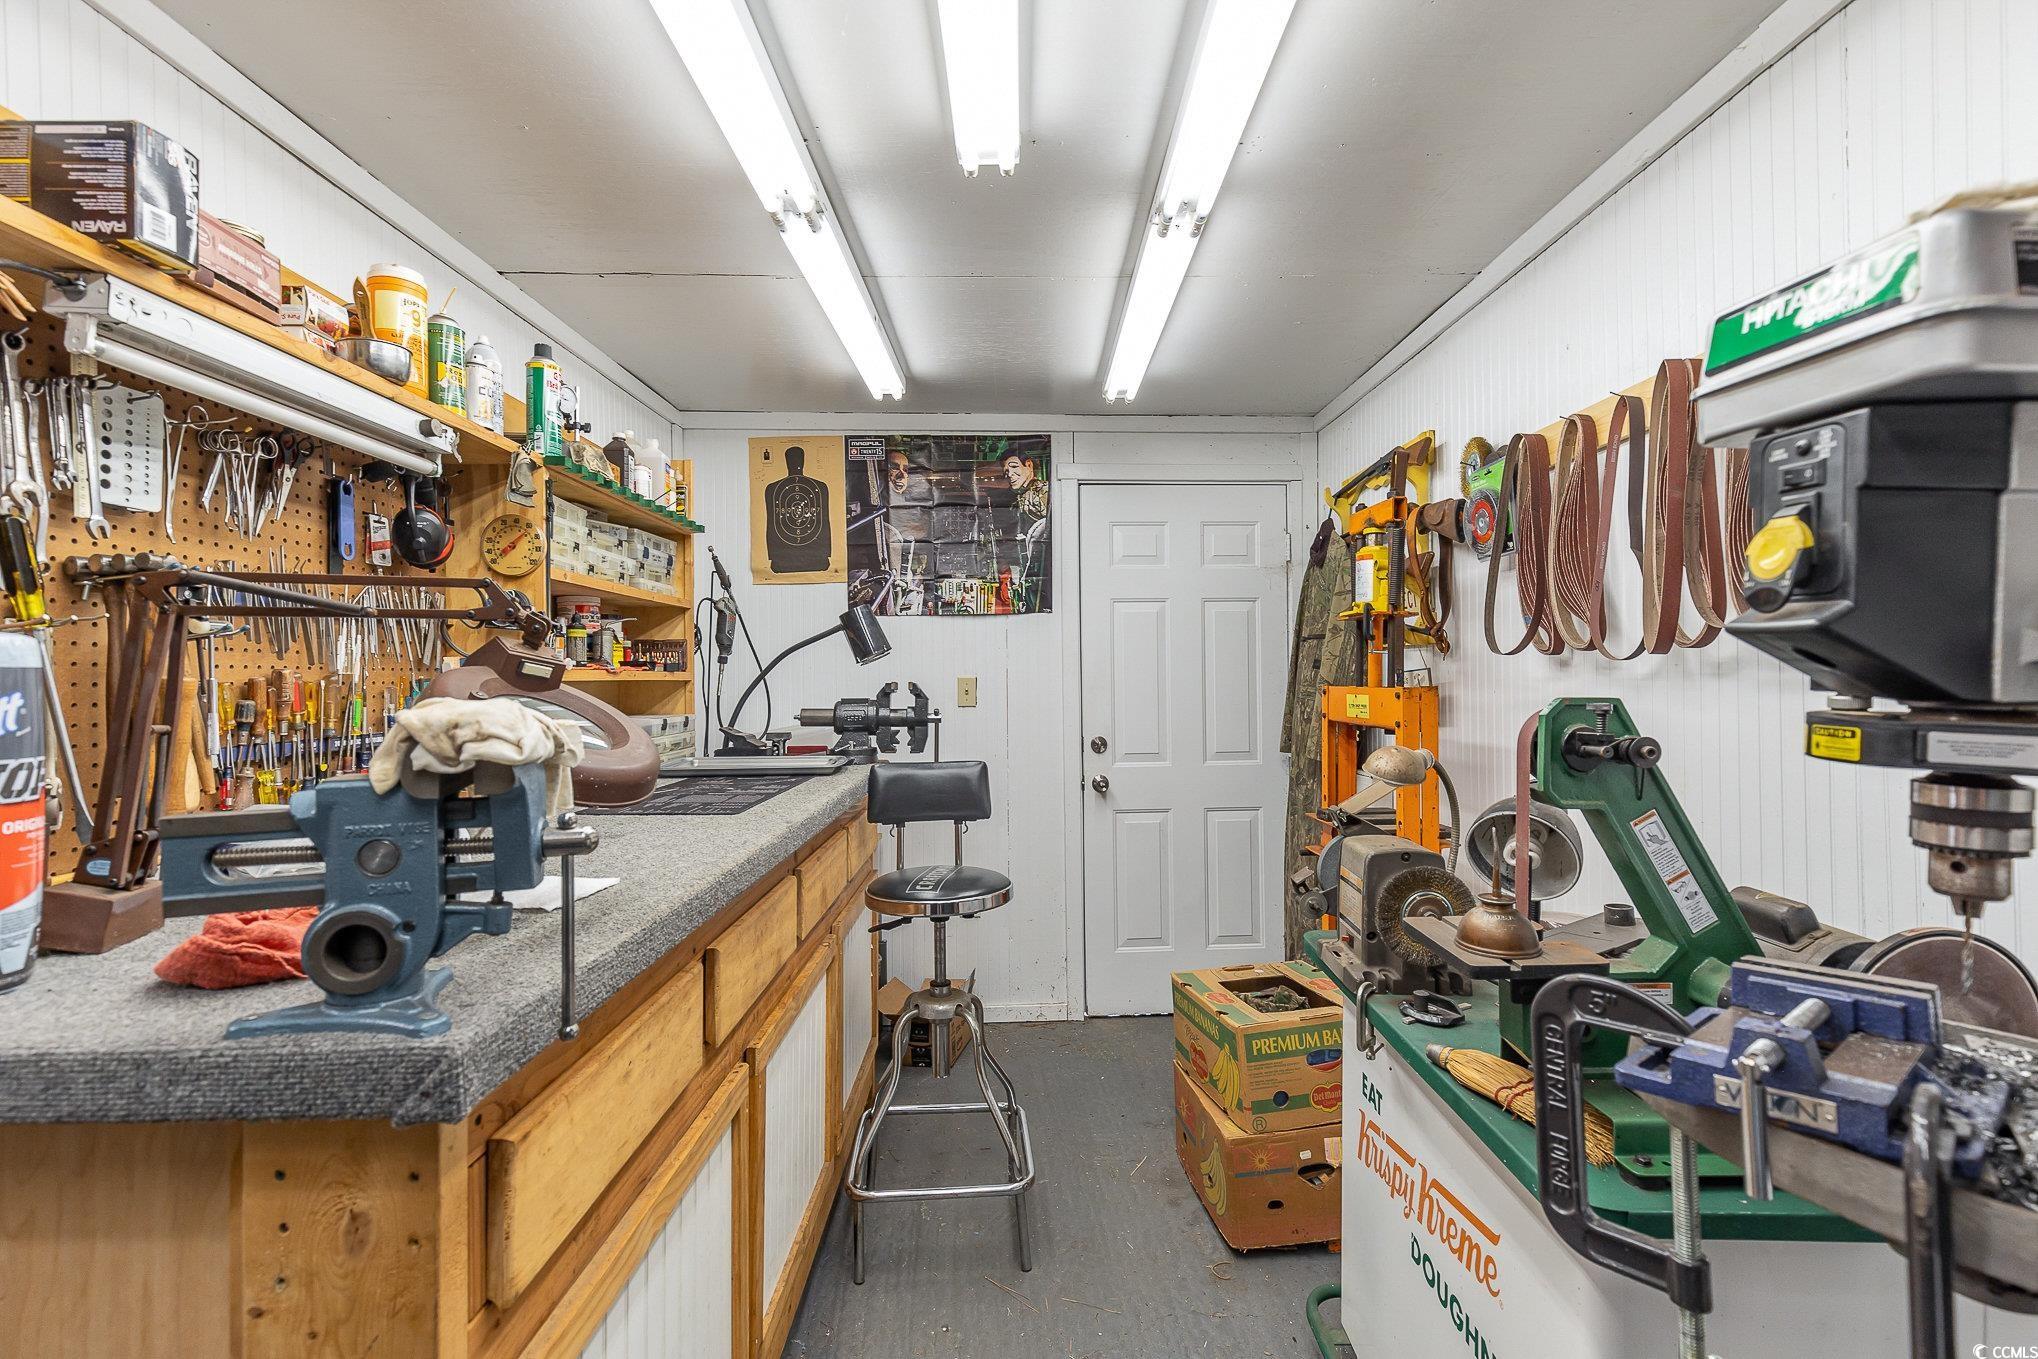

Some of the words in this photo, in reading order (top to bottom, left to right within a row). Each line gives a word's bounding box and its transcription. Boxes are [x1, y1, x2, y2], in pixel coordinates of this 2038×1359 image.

[71, 219, 127, 235] RAVEN
[1815, 727, 1852, 738] CAUTION
[1252, 1031, 1320, 1056] PREMIUM
[1545, 1023, 1568, 1110] CENTRAL
[1325, 1090, 1342, 1099] Mont
[1362, 1072, 1384, 1115] EAT
[1356, 1108, 1417, 1219] Krispy
[1416, 1162, 1501, 1298] Kreme
